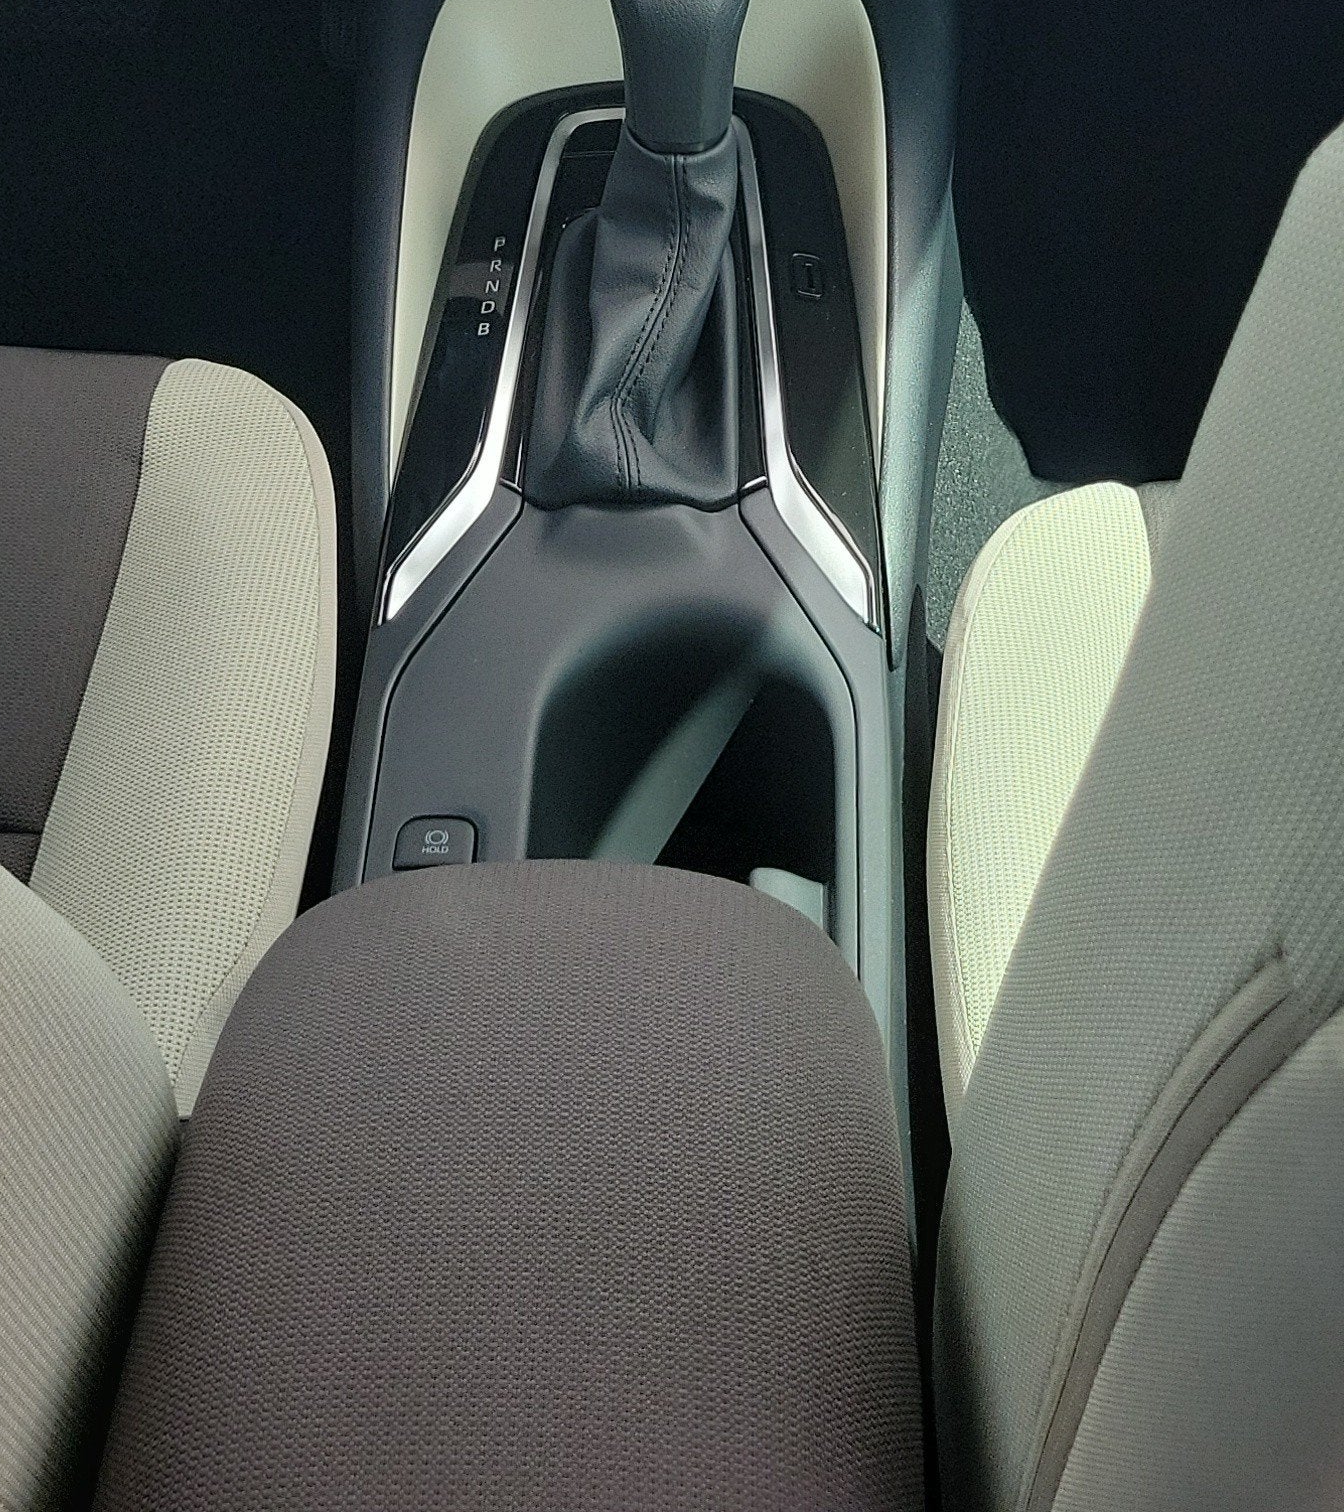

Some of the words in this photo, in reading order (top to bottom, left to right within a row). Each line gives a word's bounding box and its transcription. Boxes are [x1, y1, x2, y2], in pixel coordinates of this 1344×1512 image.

[494, 237, 506, 252] P
[490, 259, 501, 272] R
[485, 279, 499, 293] N
[481, 301, 495, 314] D
[477, 322, 490, 336] B
[422, 846, 449, 854] HOLD
